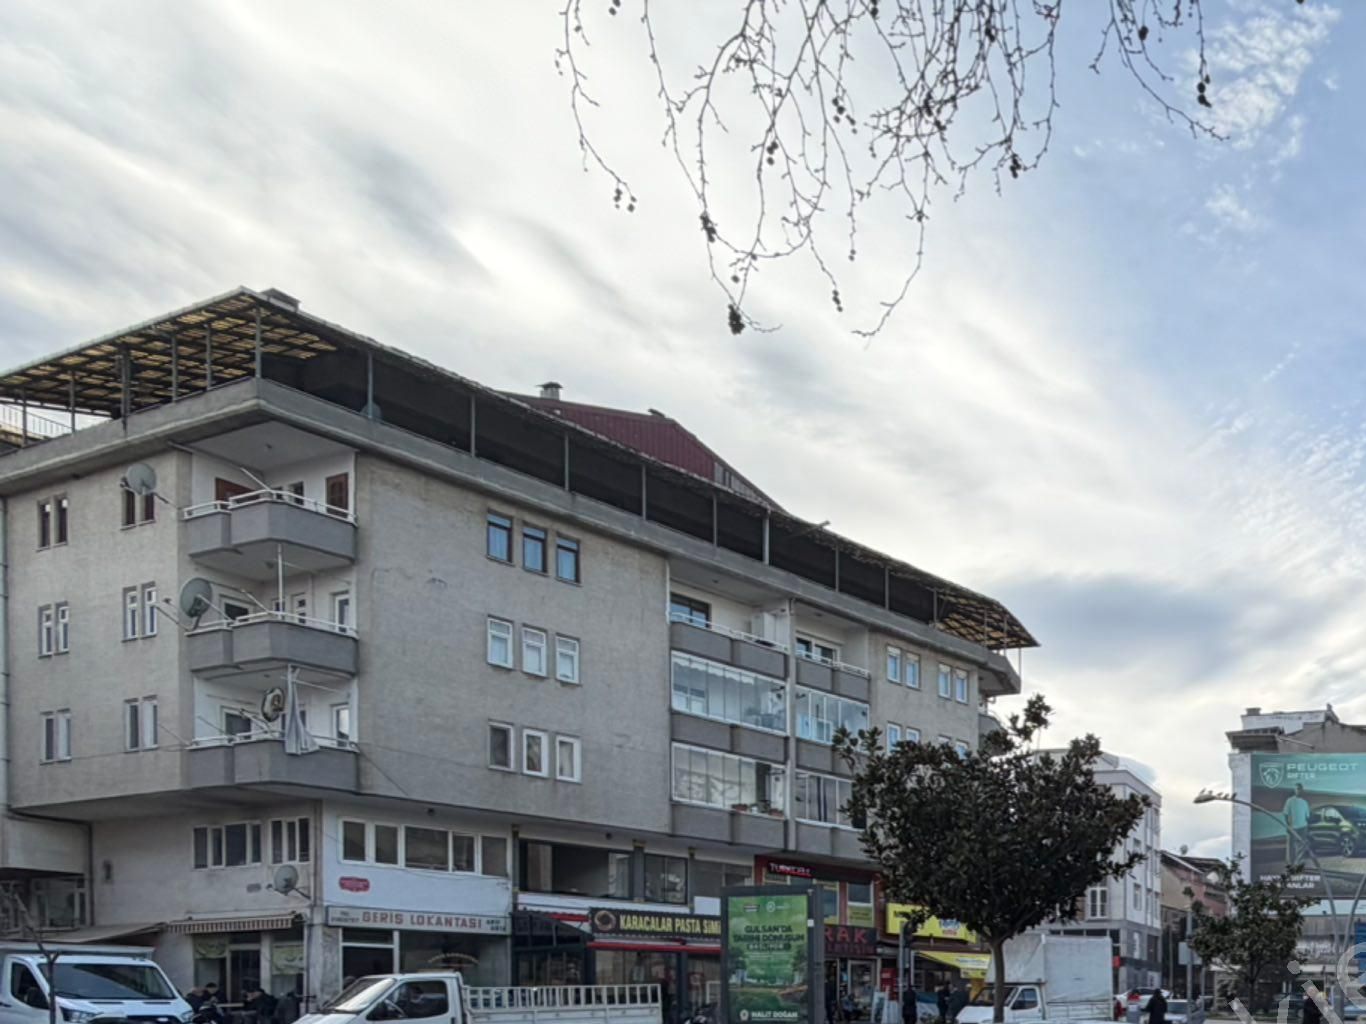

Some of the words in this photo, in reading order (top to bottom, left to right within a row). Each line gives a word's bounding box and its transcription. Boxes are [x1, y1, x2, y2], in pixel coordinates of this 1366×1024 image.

[1286, 762, 1359, 771] PEUGEOT
[410, 915, 482, 929] LOKANTASI
[675, 918, 701, 933] PASTA
